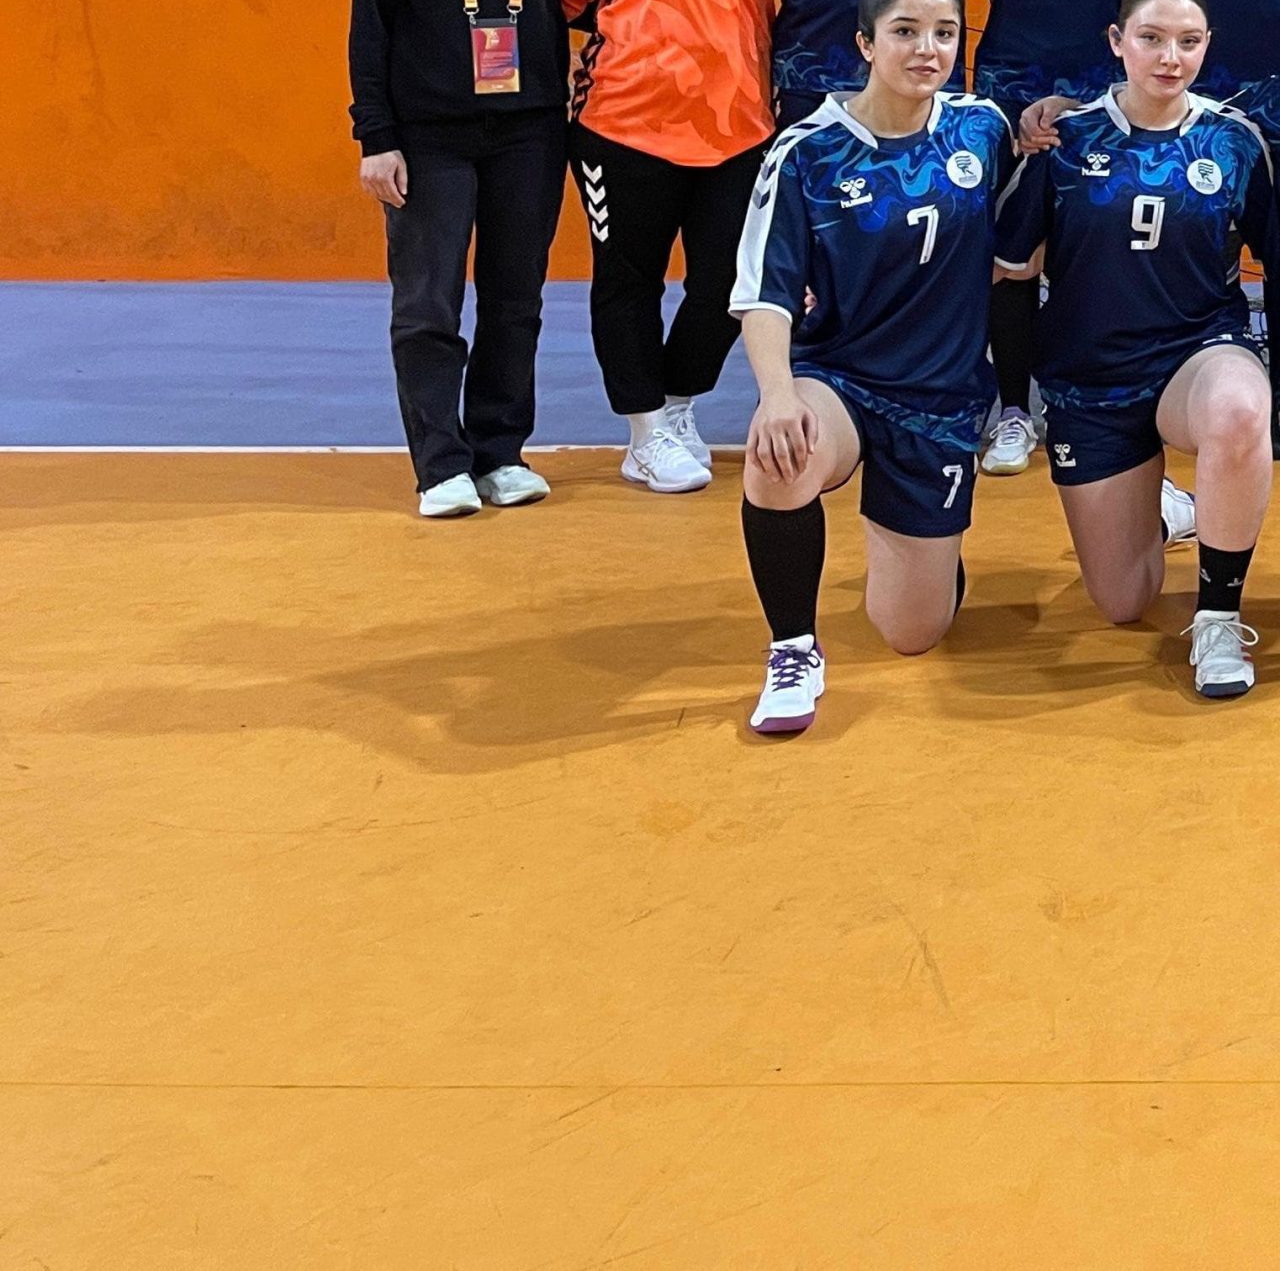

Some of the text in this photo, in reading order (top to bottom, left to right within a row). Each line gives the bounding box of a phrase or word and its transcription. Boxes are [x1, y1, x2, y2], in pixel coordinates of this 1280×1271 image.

[906, 204, 939, 265] 7
[1130, 194, 1166, 250] 9
[942, 464, 963, 508] 7
